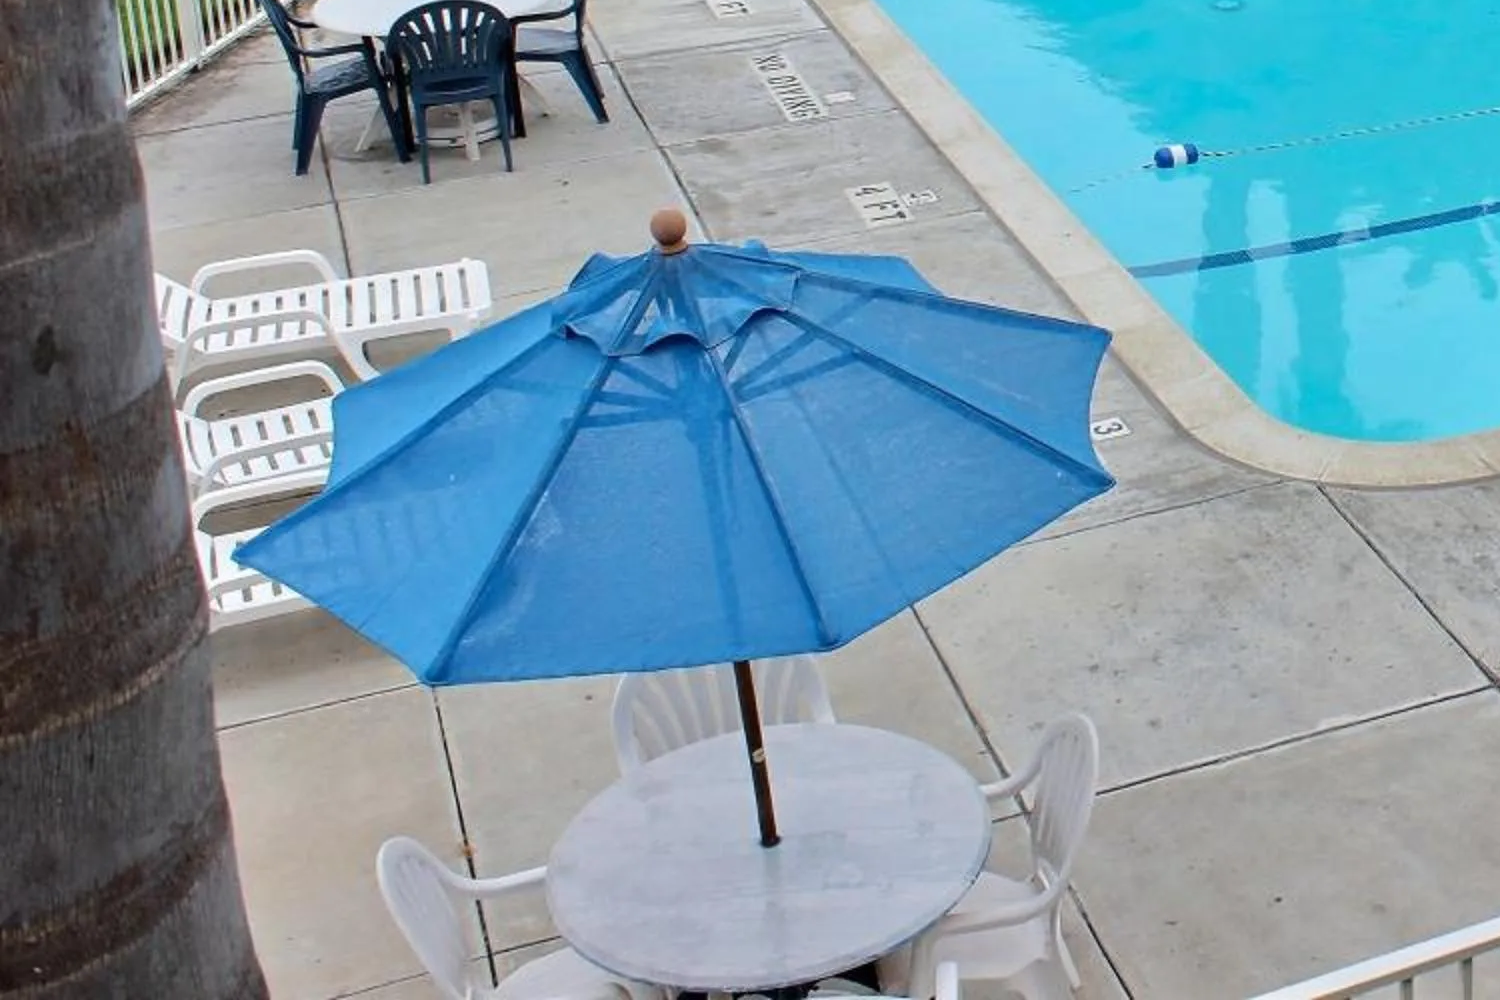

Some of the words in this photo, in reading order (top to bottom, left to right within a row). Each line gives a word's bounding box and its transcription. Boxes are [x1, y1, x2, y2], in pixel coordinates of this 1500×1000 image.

[752, 54, 787, 71] NO
[767, 75, 821, 118] DIVING
[863, 199, 907, 222] FT
[1093, 421, 1123, 435] 3
